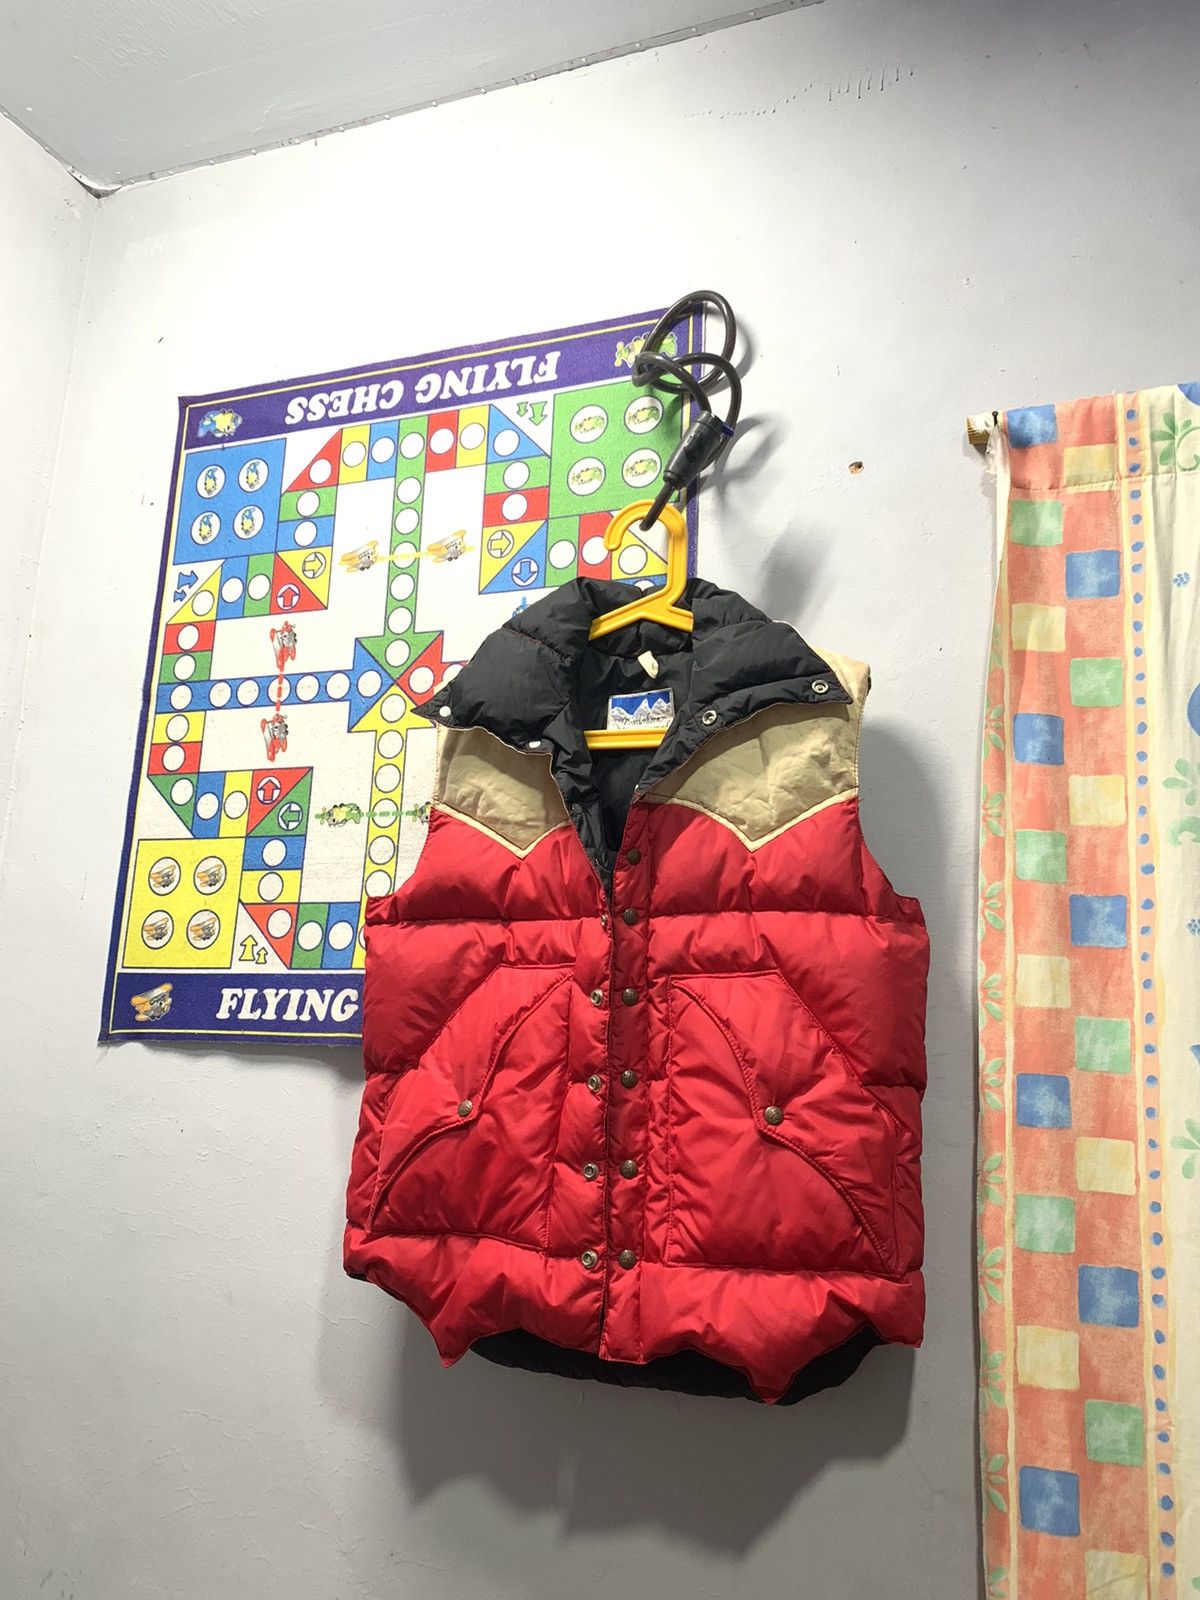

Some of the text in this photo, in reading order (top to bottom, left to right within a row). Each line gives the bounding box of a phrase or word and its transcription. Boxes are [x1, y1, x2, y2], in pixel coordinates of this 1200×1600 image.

[285, 351, 561, 425] FLYING CHESS
[216, 988, 358, 1022] FLYING
